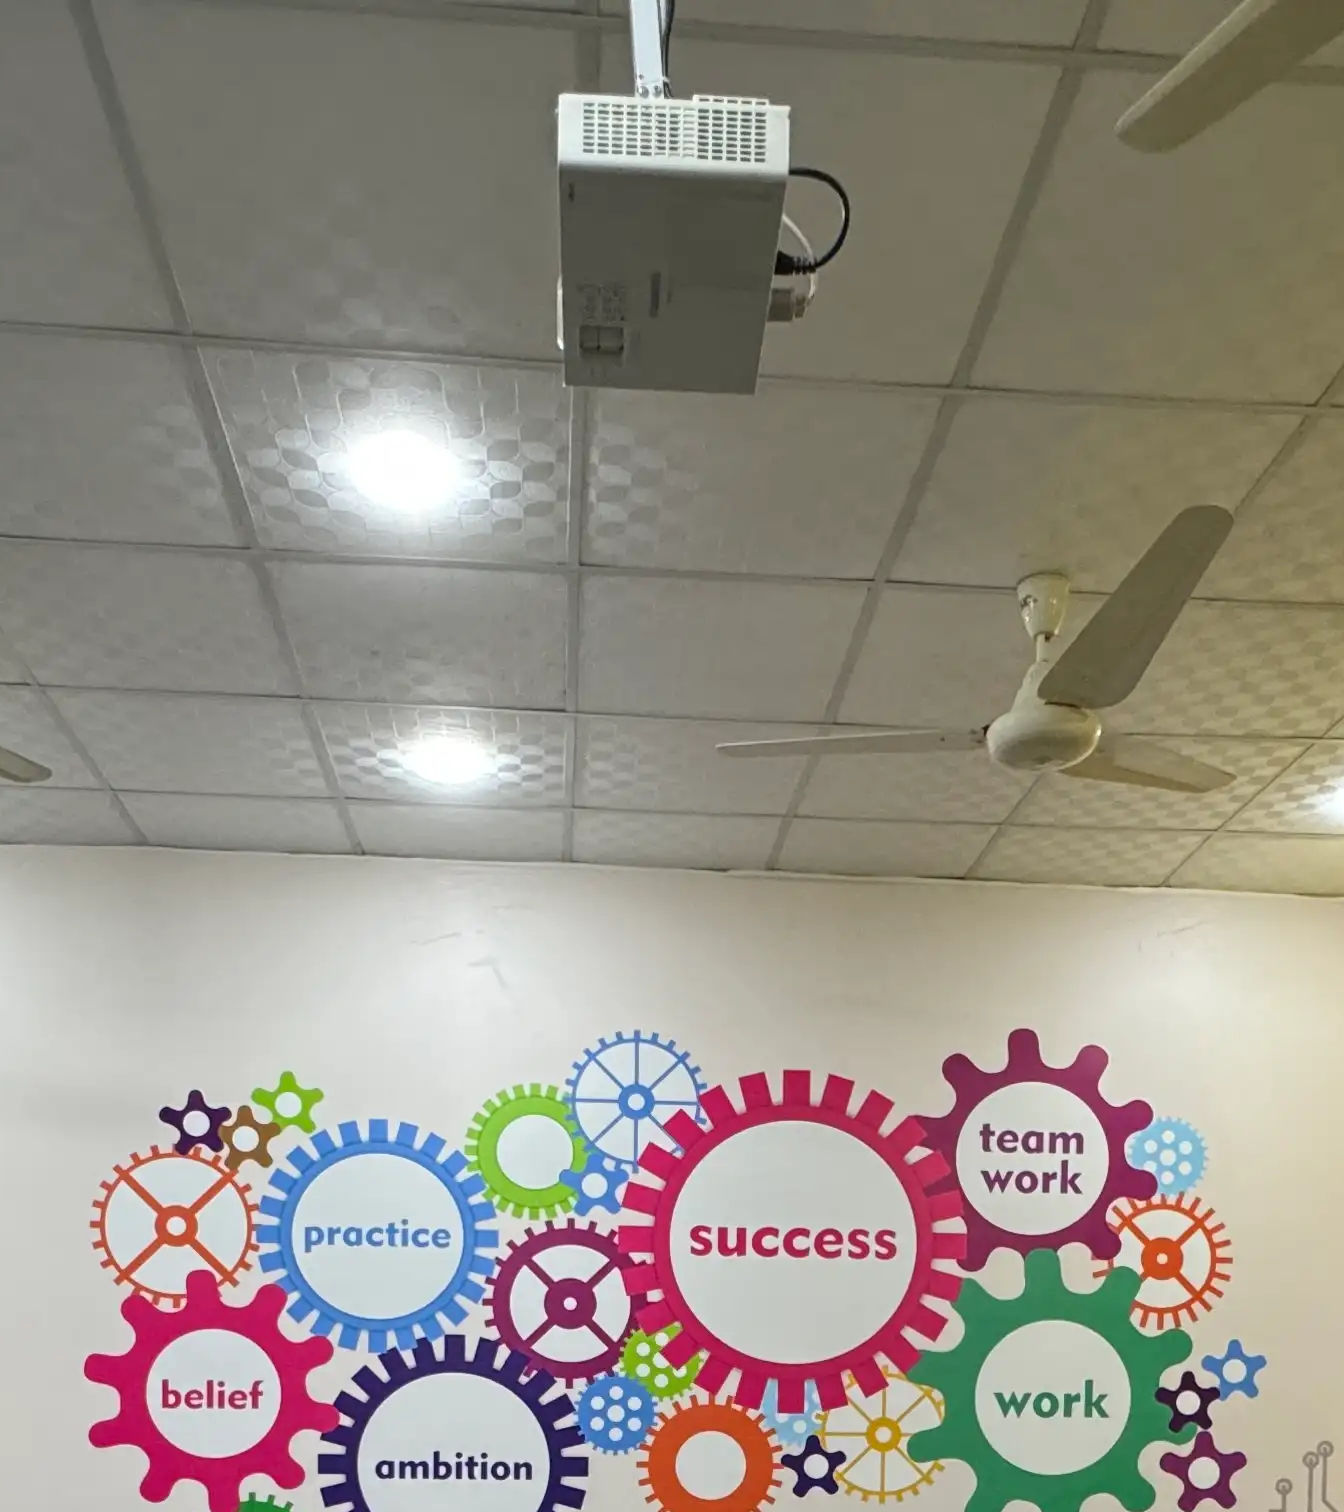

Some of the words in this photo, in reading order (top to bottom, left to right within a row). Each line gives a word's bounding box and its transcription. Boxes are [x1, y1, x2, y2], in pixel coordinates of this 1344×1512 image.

[979, 1122, 1085, 1156] team
[980, 1161, 1084, 1195] work
[303, 1219, 452, 1253] practice
[689, 1224, 898, 1260] success
[160, 1379, 264, 1410] belief
[994, 1379, 1110, 1419] work
[374, 1450, 534, 1482] ambition
